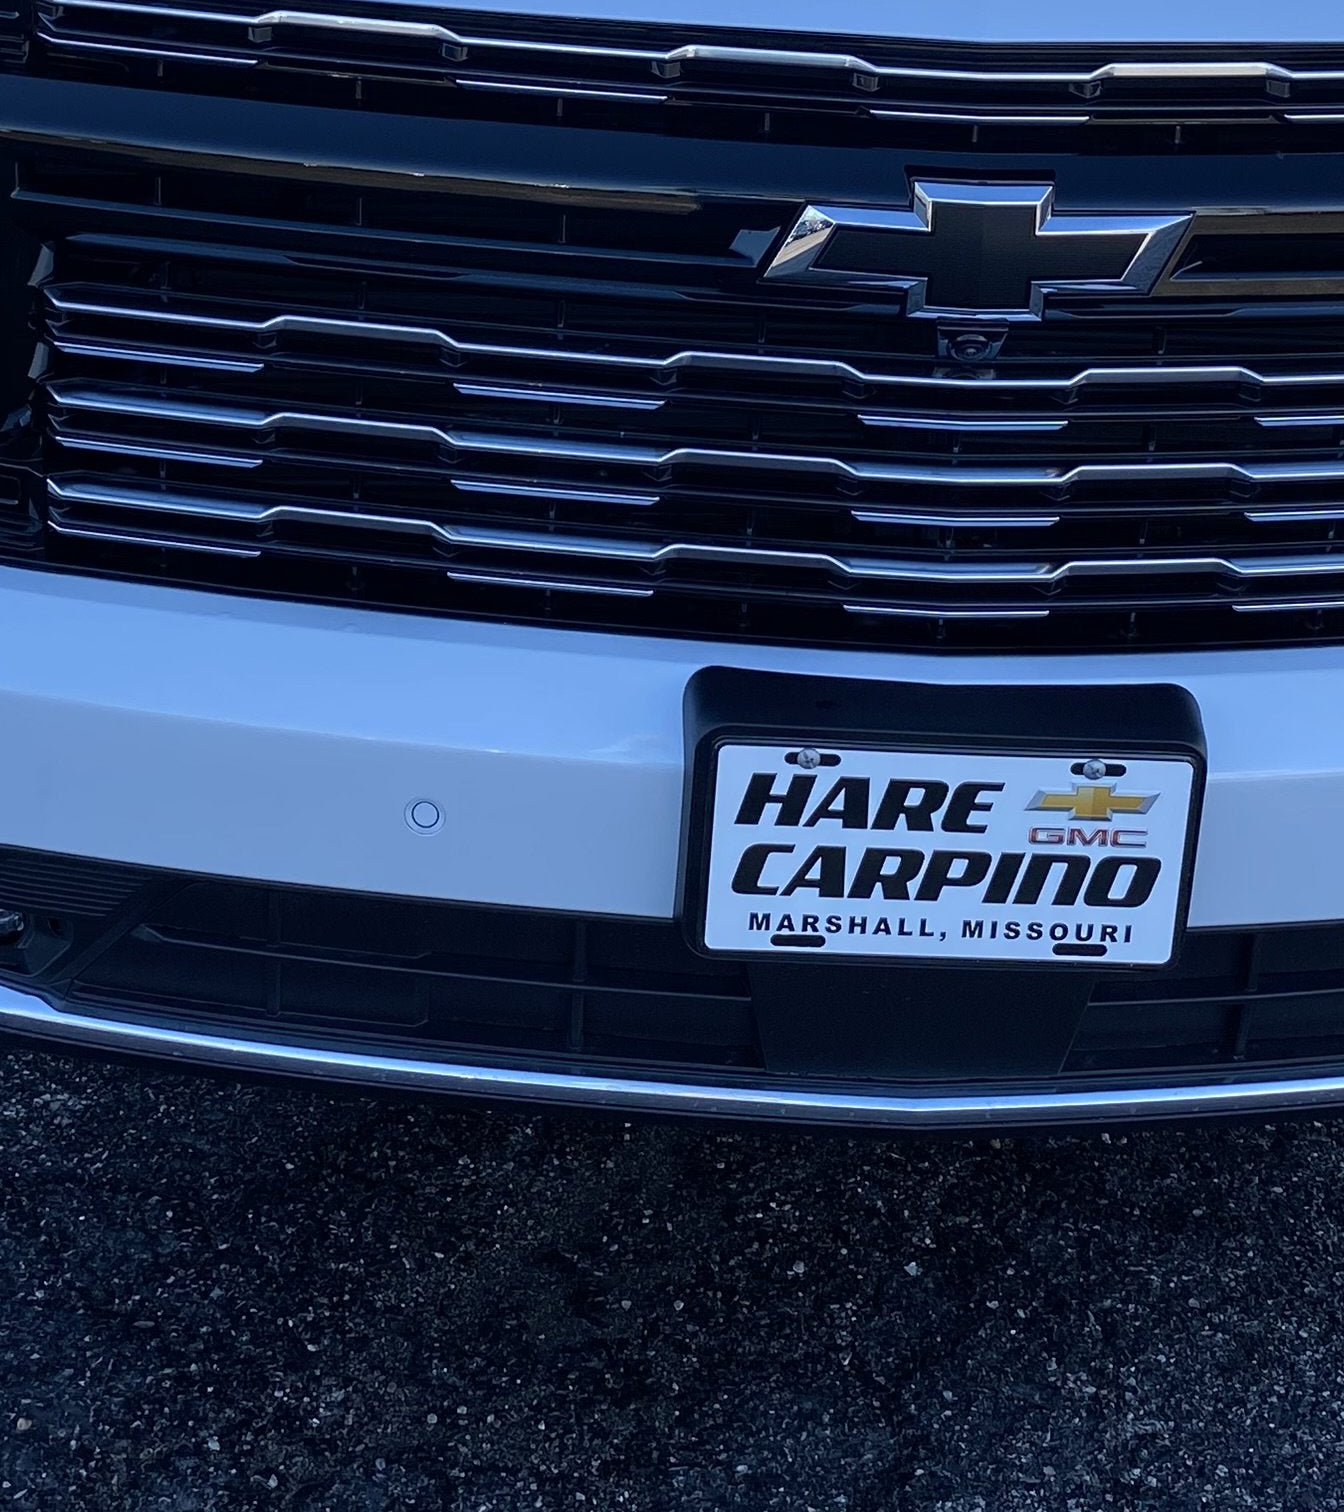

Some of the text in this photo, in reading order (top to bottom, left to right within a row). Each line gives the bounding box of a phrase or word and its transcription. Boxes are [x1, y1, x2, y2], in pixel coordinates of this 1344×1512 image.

[733, 772, 1005, 833] HARE
[1027, 826, 1148, 848] GMC
[731, 843, 1162, 908] CARPINO
[748, 911, 1133, 943] MARSHALL, MISSOURI
